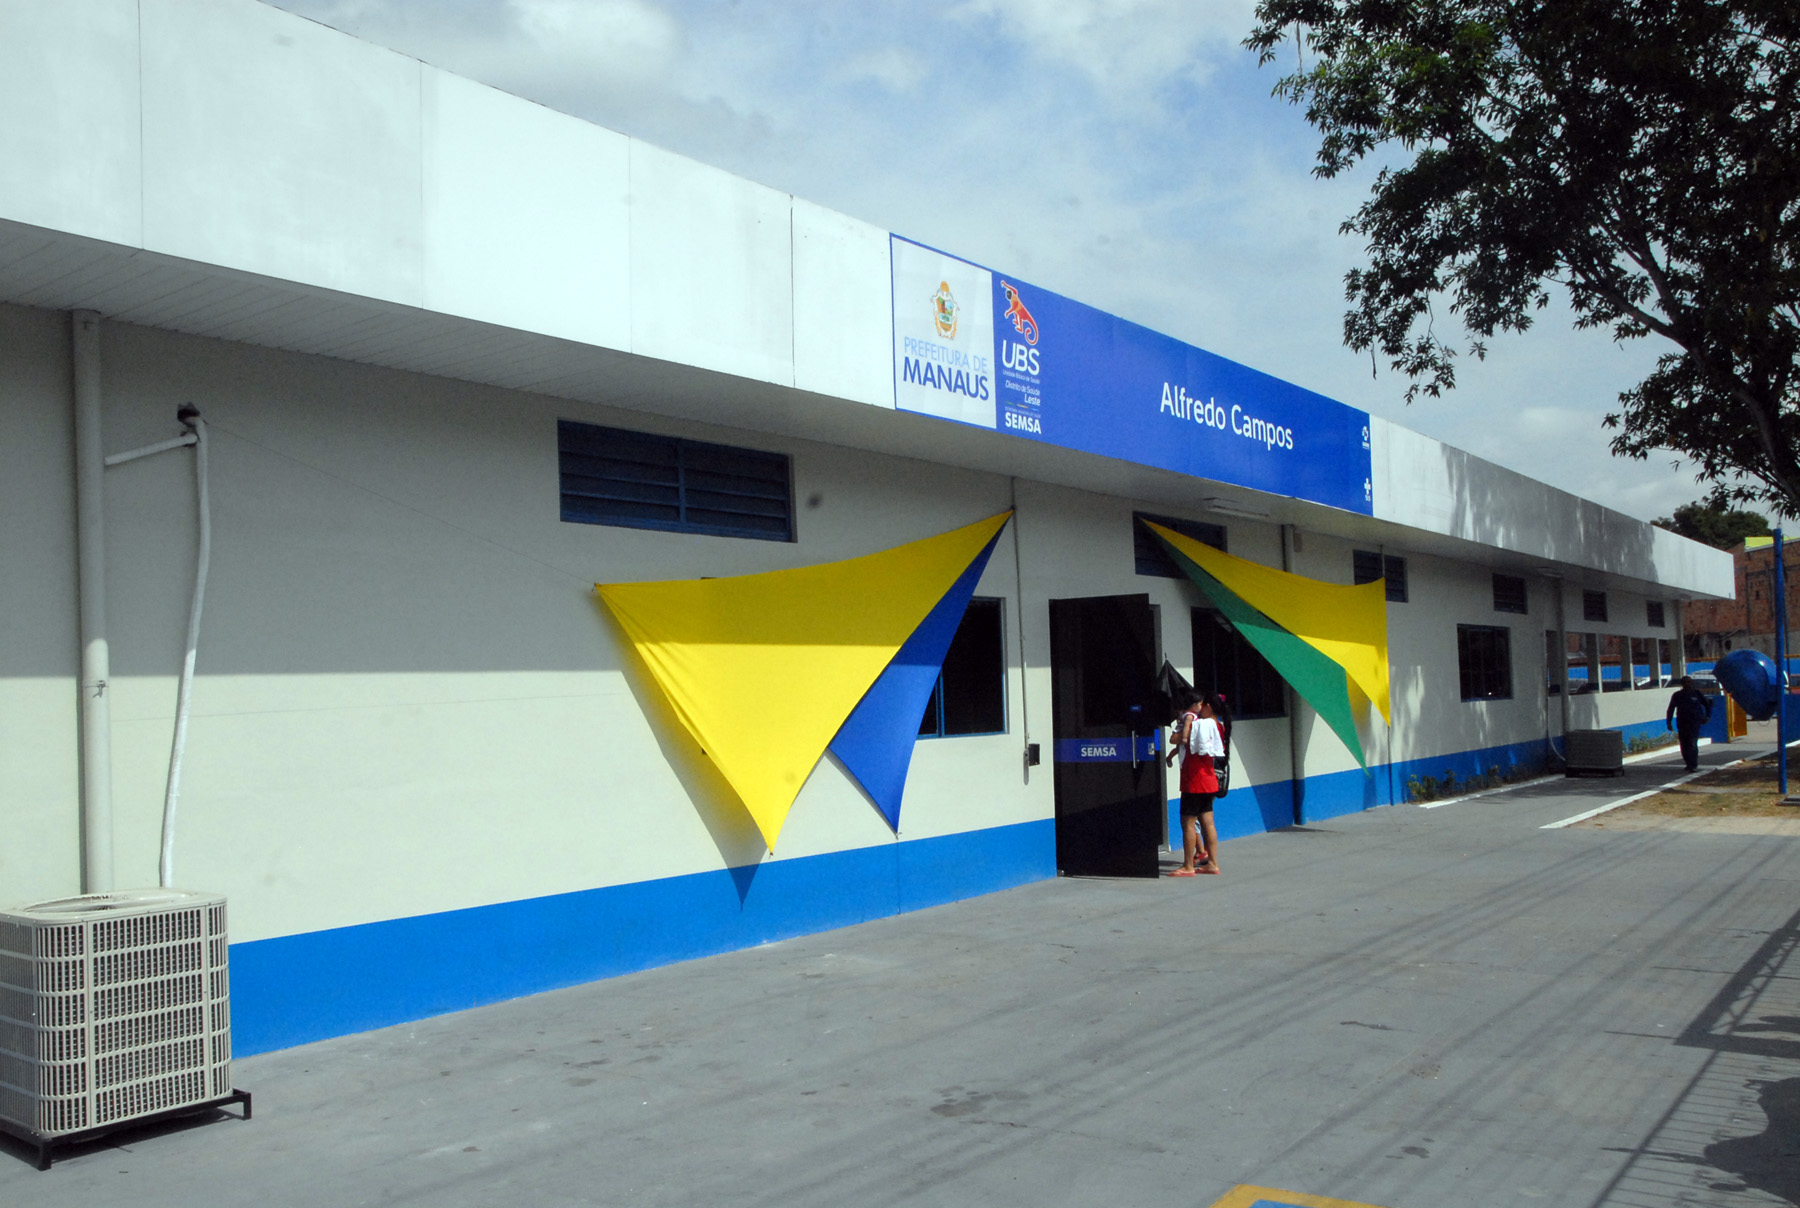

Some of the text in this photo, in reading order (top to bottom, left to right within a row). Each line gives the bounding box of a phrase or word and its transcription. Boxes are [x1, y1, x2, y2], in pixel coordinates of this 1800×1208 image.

[904, 337, 987, 374] PREFEITURA DE
[1002, 340, 1040, 376] UBS
[903, 356, 989, 401] MANAUS
[1005, 379, 1021, 391] Distrito
[1027, 385, 1041, 396] Saúde
[1024, 393, 1041, 406] Leste
[1005, 411, 1042, 435] SEMSA
[1160, 382, 1293, 451] Alfredo Campos
[1081, 747, 1117, 757] SEMSA
